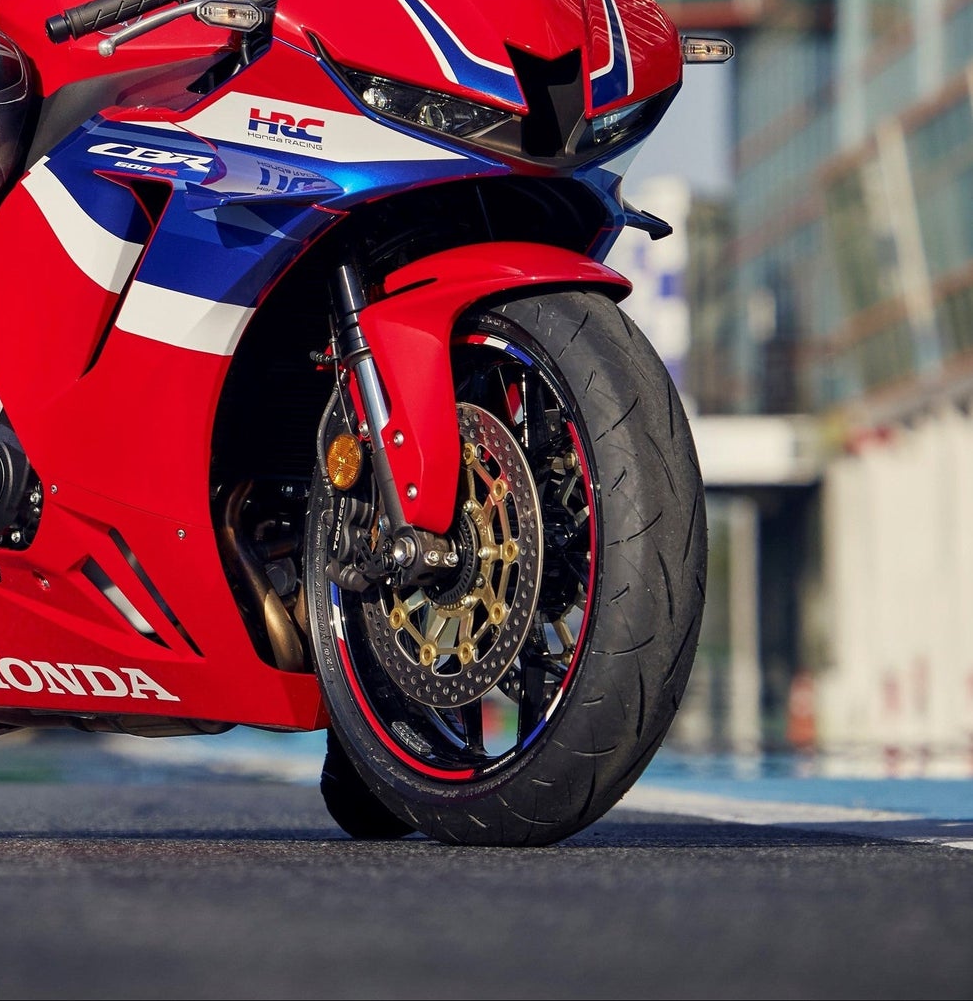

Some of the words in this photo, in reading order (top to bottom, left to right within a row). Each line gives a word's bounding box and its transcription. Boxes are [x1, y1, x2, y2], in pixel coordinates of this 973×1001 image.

[248, 107, 325, 143] HRC
[248, 132, 283, 143] Honda
[284, 138, 323, 151] RACING
[87, 142, 214, 173] CBR
[114, 161, 178, 177] 600RR
[332, 496, 346, 551] TOKICO
